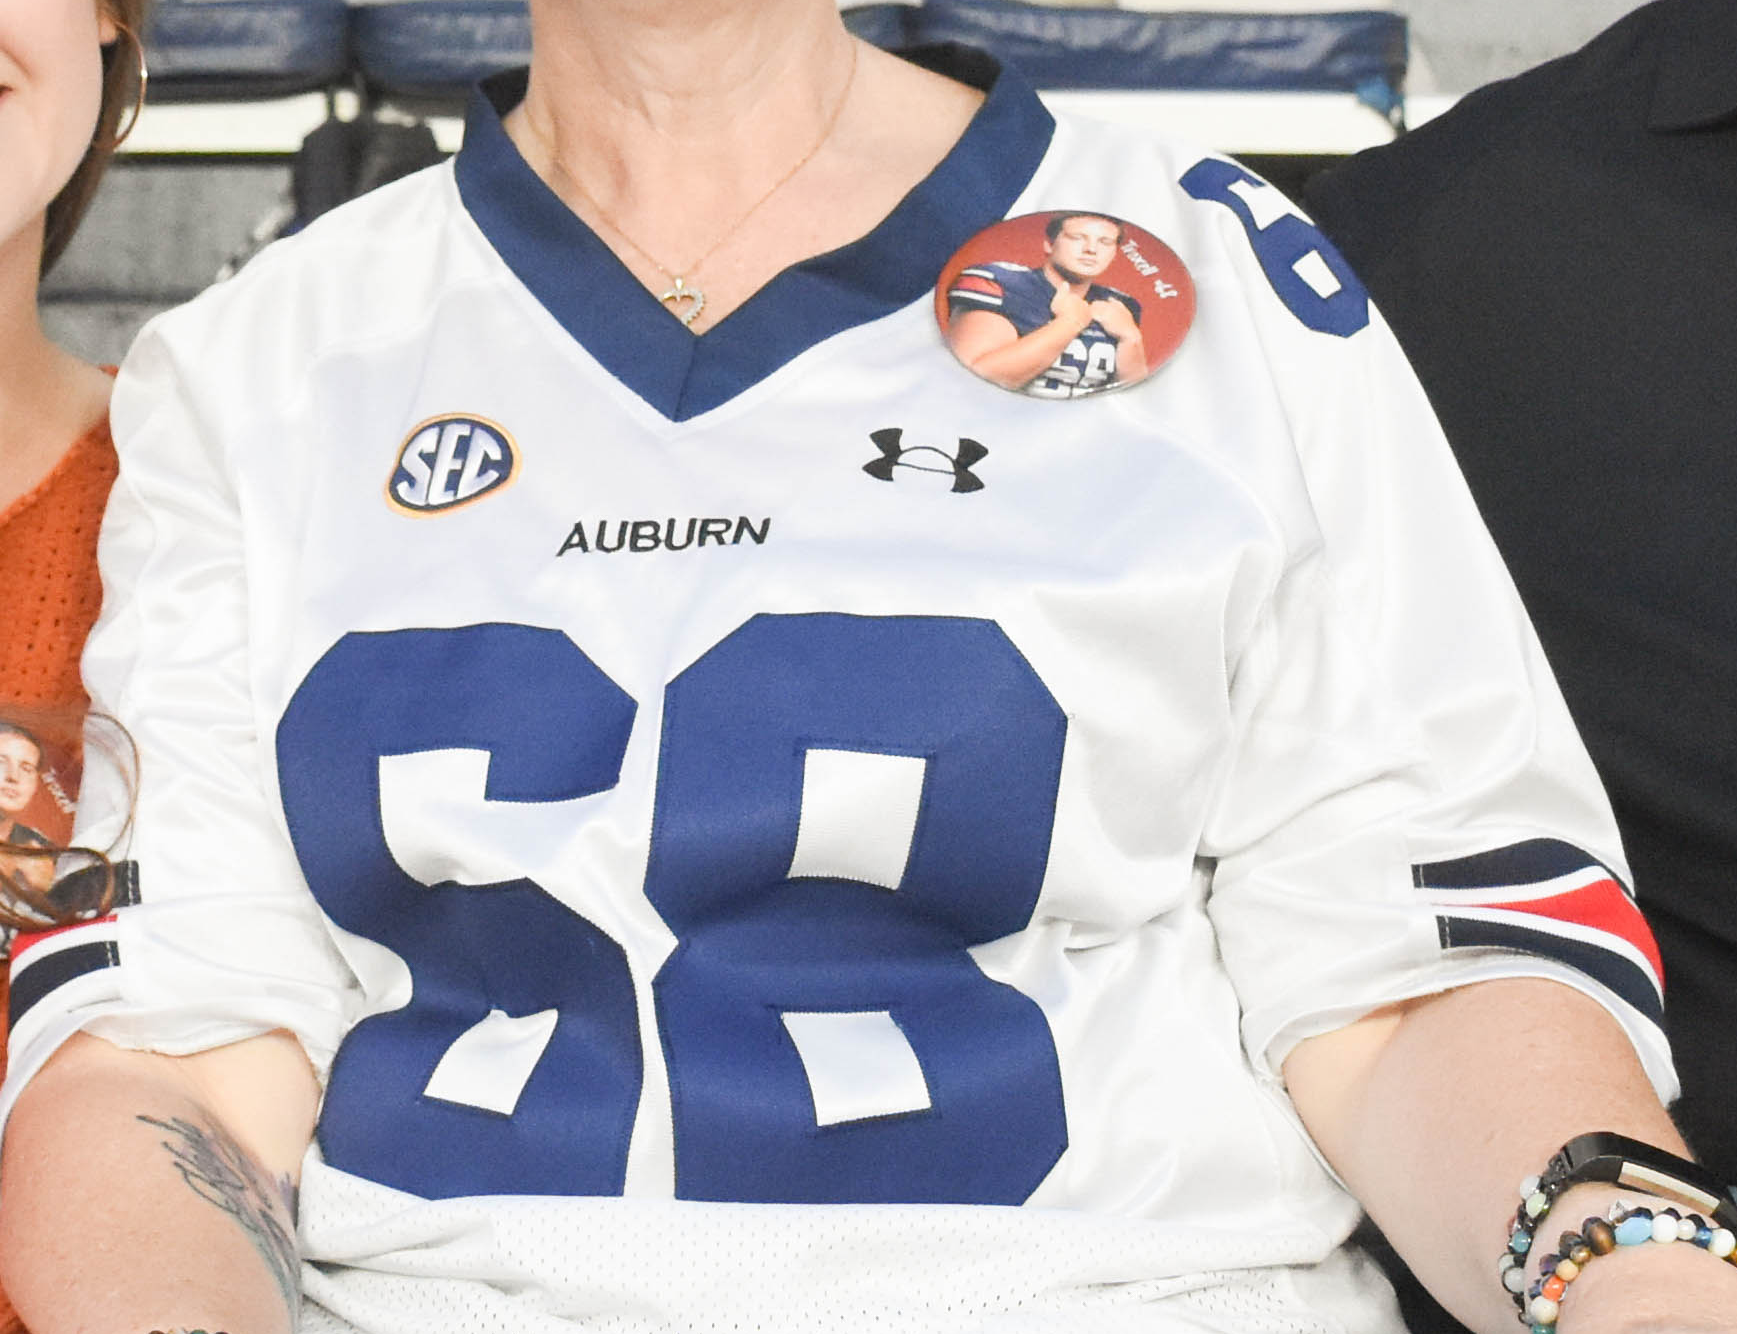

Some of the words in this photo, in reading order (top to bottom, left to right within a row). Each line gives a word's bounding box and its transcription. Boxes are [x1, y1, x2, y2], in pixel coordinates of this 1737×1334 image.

[395, 421, 504, 507] SEC
[555, 515, 772, 557] AUBURN
[275, 612, 1069, 1207] 68
